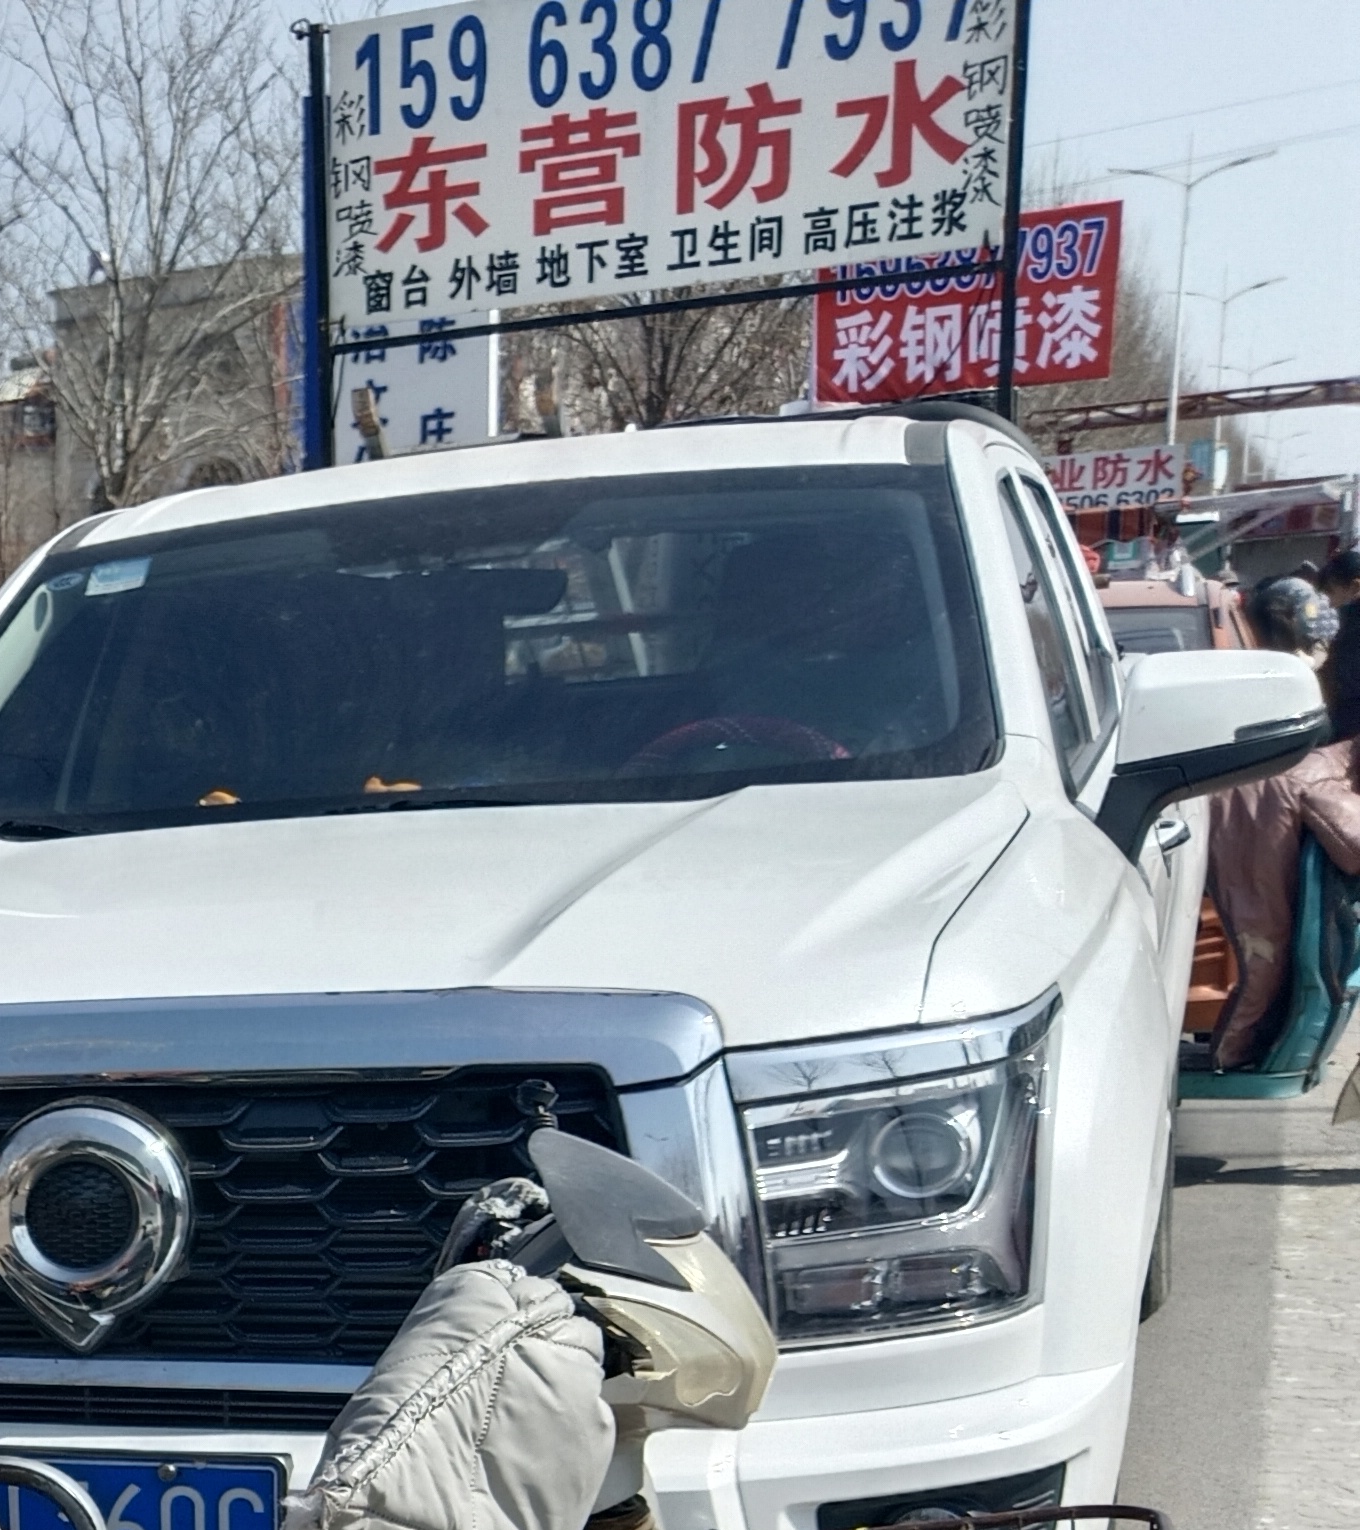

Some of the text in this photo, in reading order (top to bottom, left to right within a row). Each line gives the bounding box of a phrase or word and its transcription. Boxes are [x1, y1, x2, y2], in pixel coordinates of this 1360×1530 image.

[355, 14, 488, 136] 159
[528, 0, 722, 108] 6387
[374, 59, 970, 254] 东营防水
[363, 188, 969, 315] 窗台 外墙 地下室 卫生间 高压注浆
[832, 285, 1102, 393] 彩钢喷漆
[1051, 449, 1175, 492] 业防水
